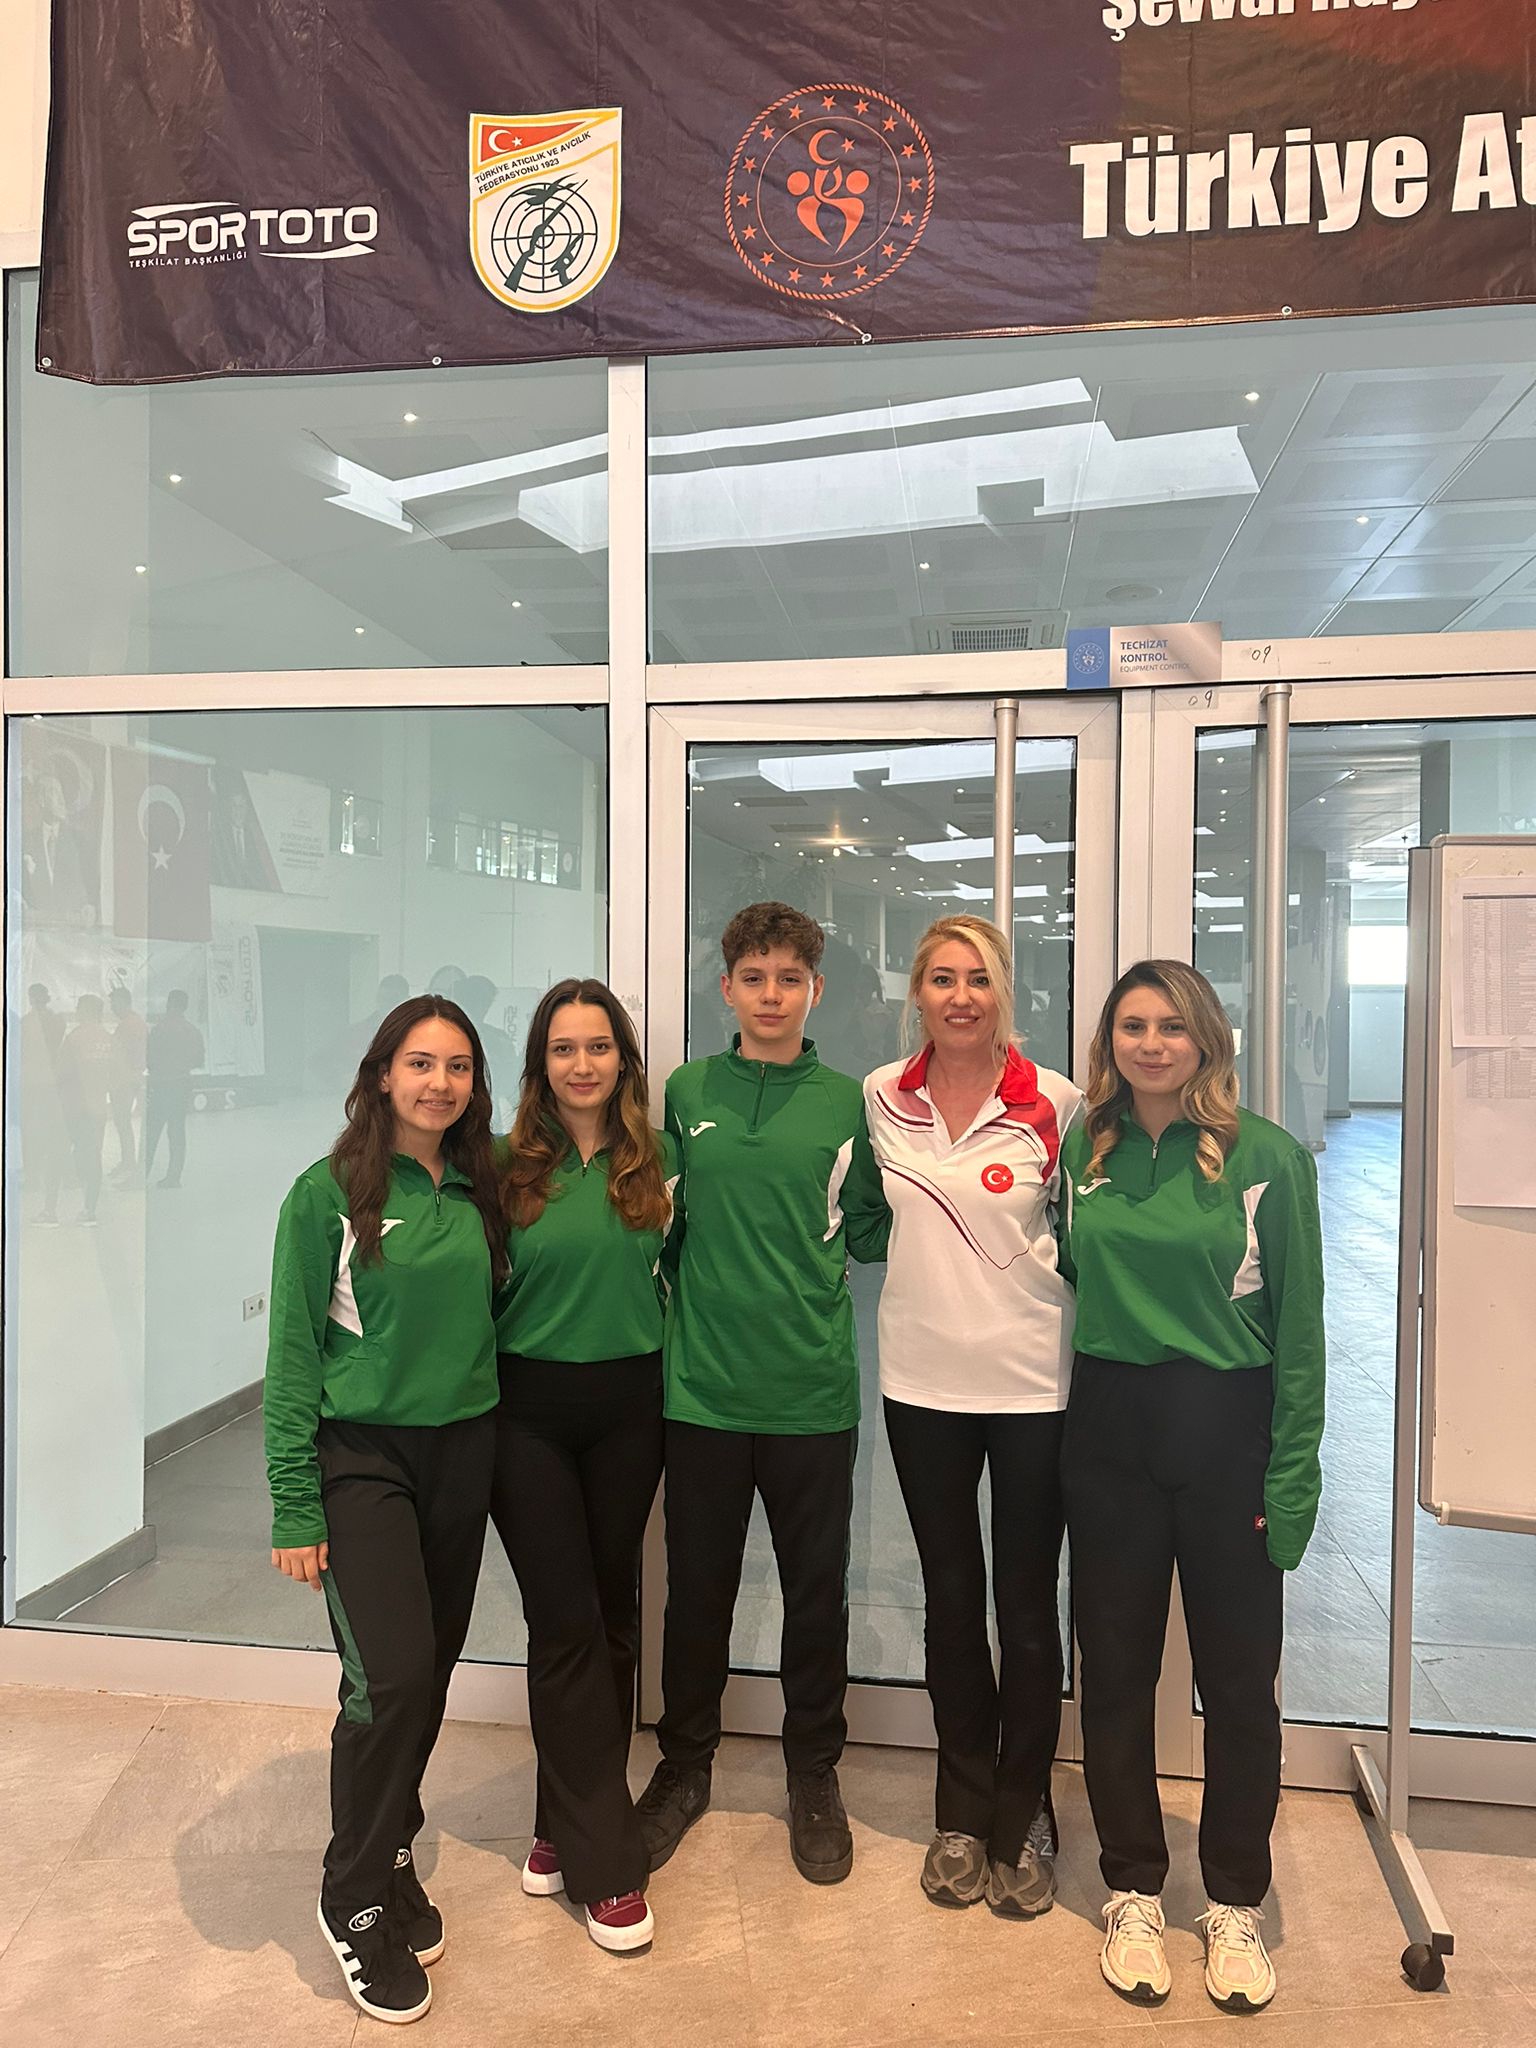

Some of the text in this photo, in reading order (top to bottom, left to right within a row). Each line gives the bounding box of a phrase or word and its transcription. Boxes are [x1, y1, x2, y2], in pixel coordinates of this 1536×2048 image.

[475, 131, 592, 184] TÜRKİYE ATICILIK VE AVCILIK
[478, 158, 560, 194] FEDERASYONU 1923
[1069, 127, 1430, 239] Türkiye
[128, 250, 248, 269] TEŞKİLAT BAŞKANLIĞI
[1120, 639, 1169, 651] TECHİZAT
[1120, 652, 1169, 663] KONTROL
[1119, 662, 1191, 674] EQUIPMENT CONTROL
